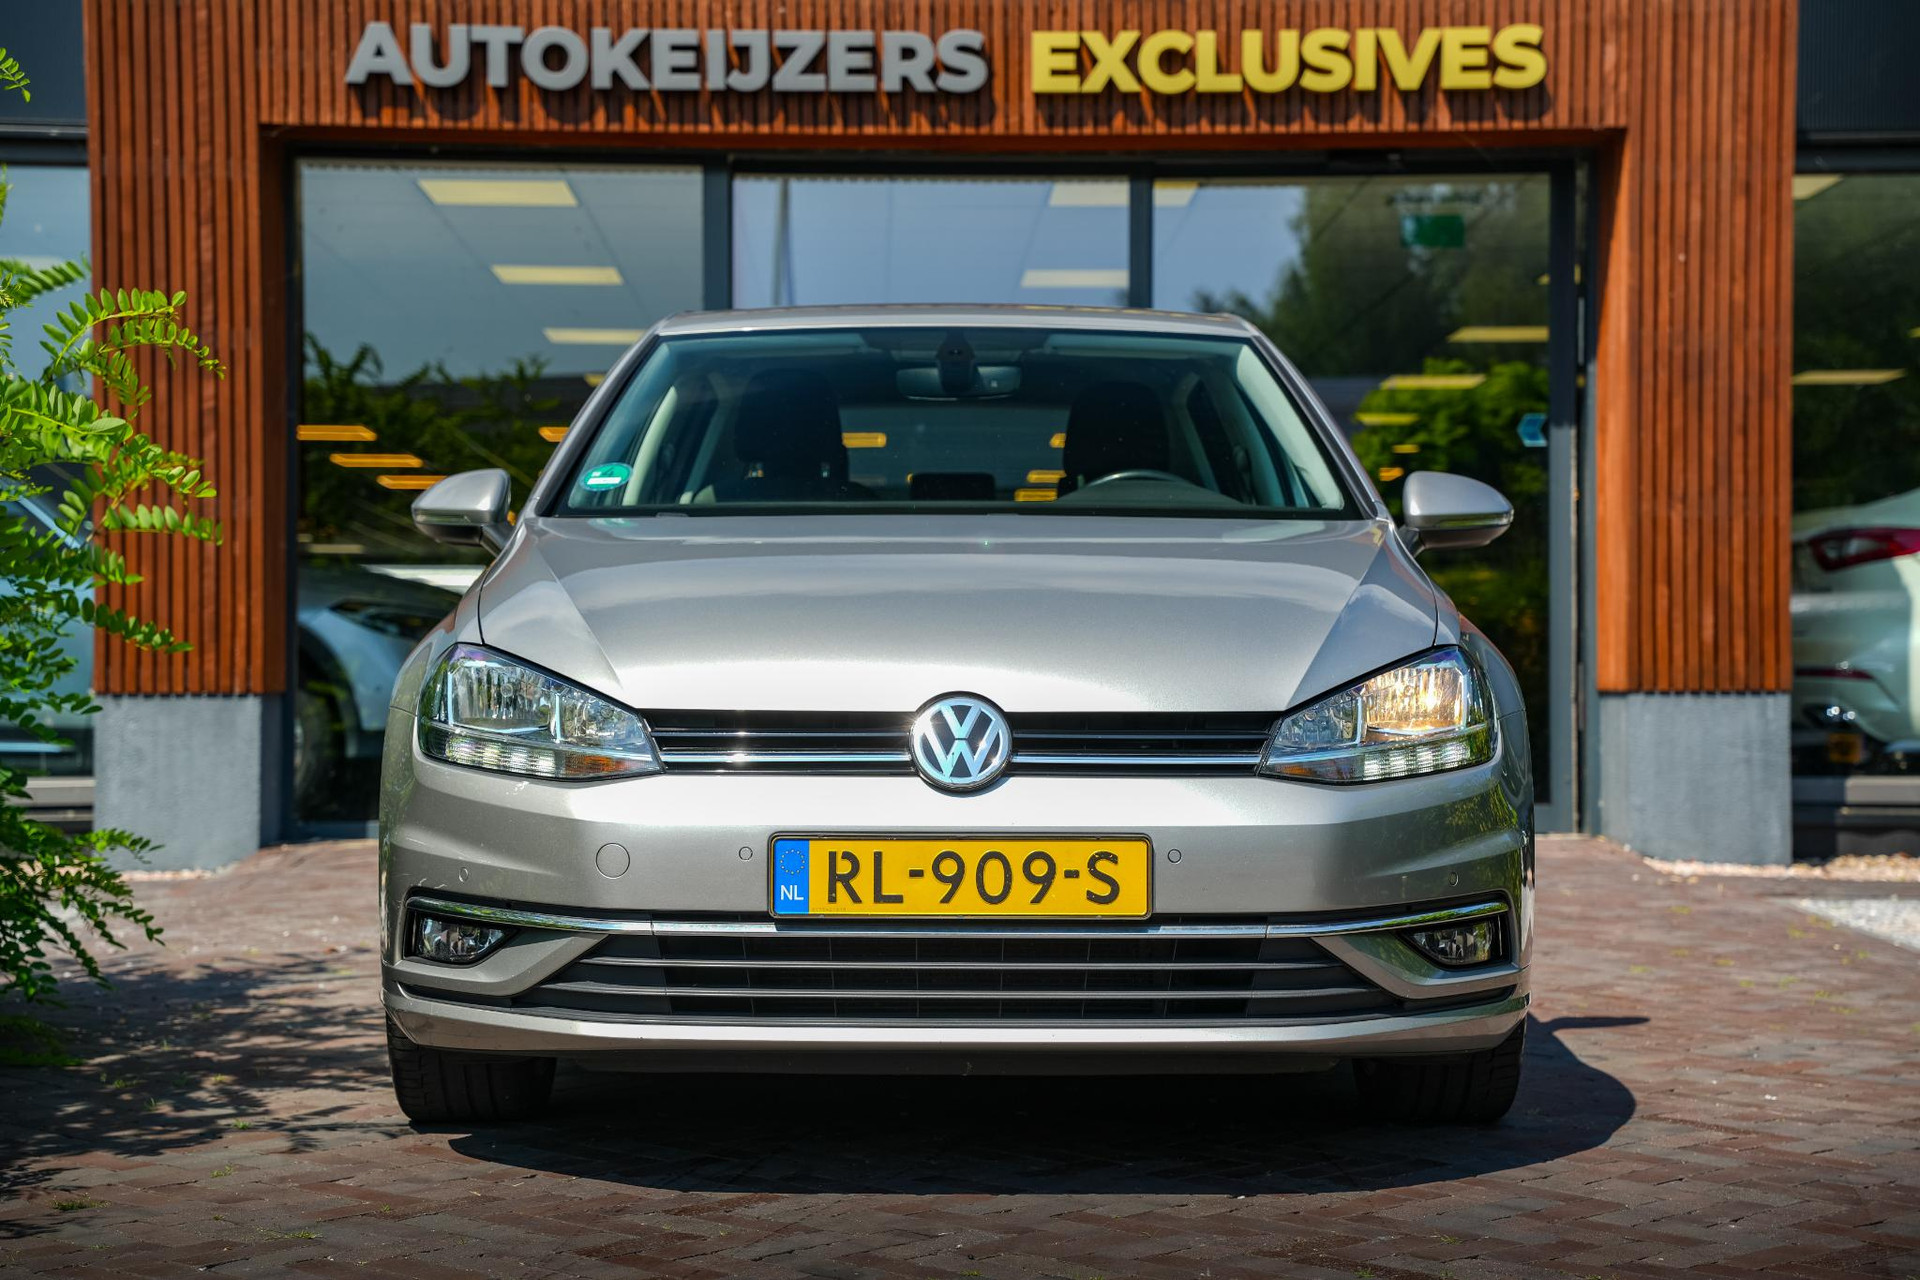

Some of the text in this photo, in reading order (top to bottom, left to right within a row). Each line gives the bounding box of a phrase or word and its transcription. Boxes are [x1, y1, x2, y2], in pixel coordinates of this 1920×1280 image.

[345, 21, 1547, 95] AUTOKEIJZERS EXCLUSIVES
[913, 699, 1008, 783] VW
[780, 884, 804, 901] NL
[827, 850, 1120, 904] RL-909-S
